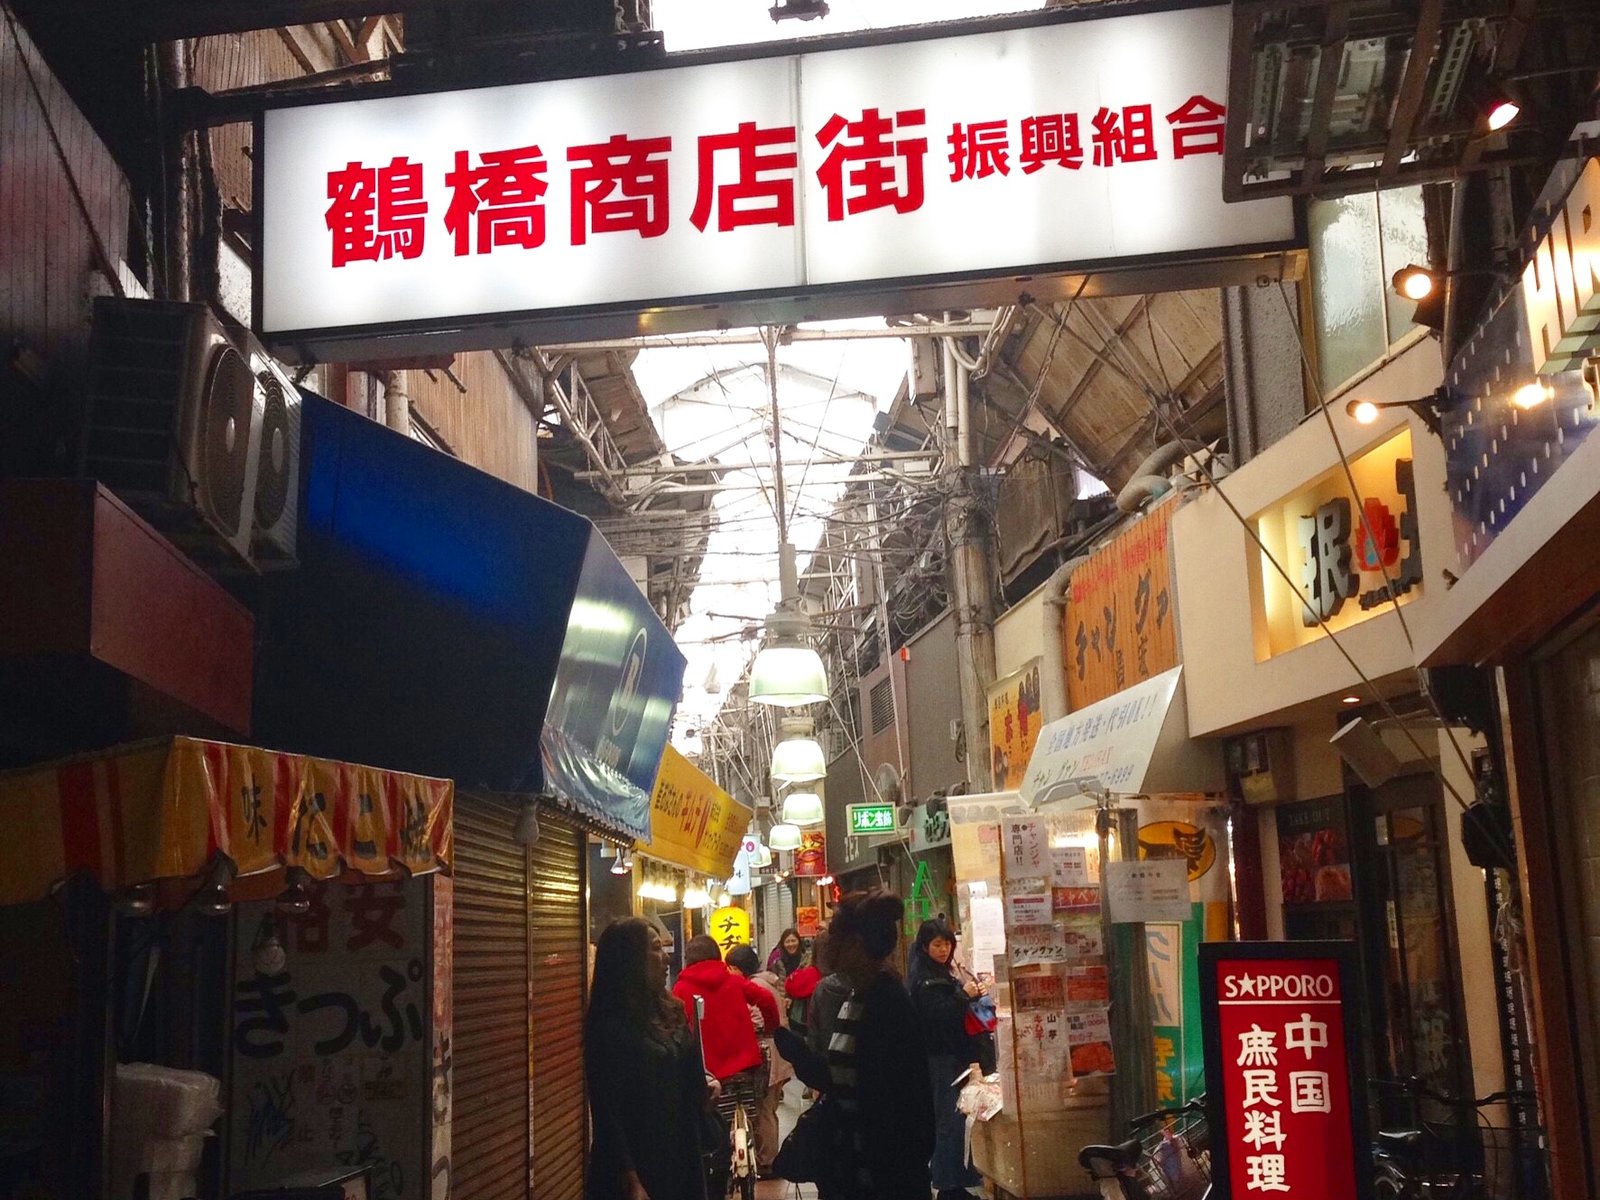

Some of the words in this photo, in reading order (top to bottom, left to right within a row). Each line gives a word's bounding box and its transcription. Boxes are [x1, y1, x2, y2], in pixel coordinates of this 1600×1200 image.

[324, 120, 927, 267] 鶴橋商店街
[947, 95, 1227, 183] 振興組合
[854, 810, 893, 828] リボン宝飾
[1236, 1023, 1291, 1192] 庶民料理
[1285, 1012, 1332, 1114] 中国
